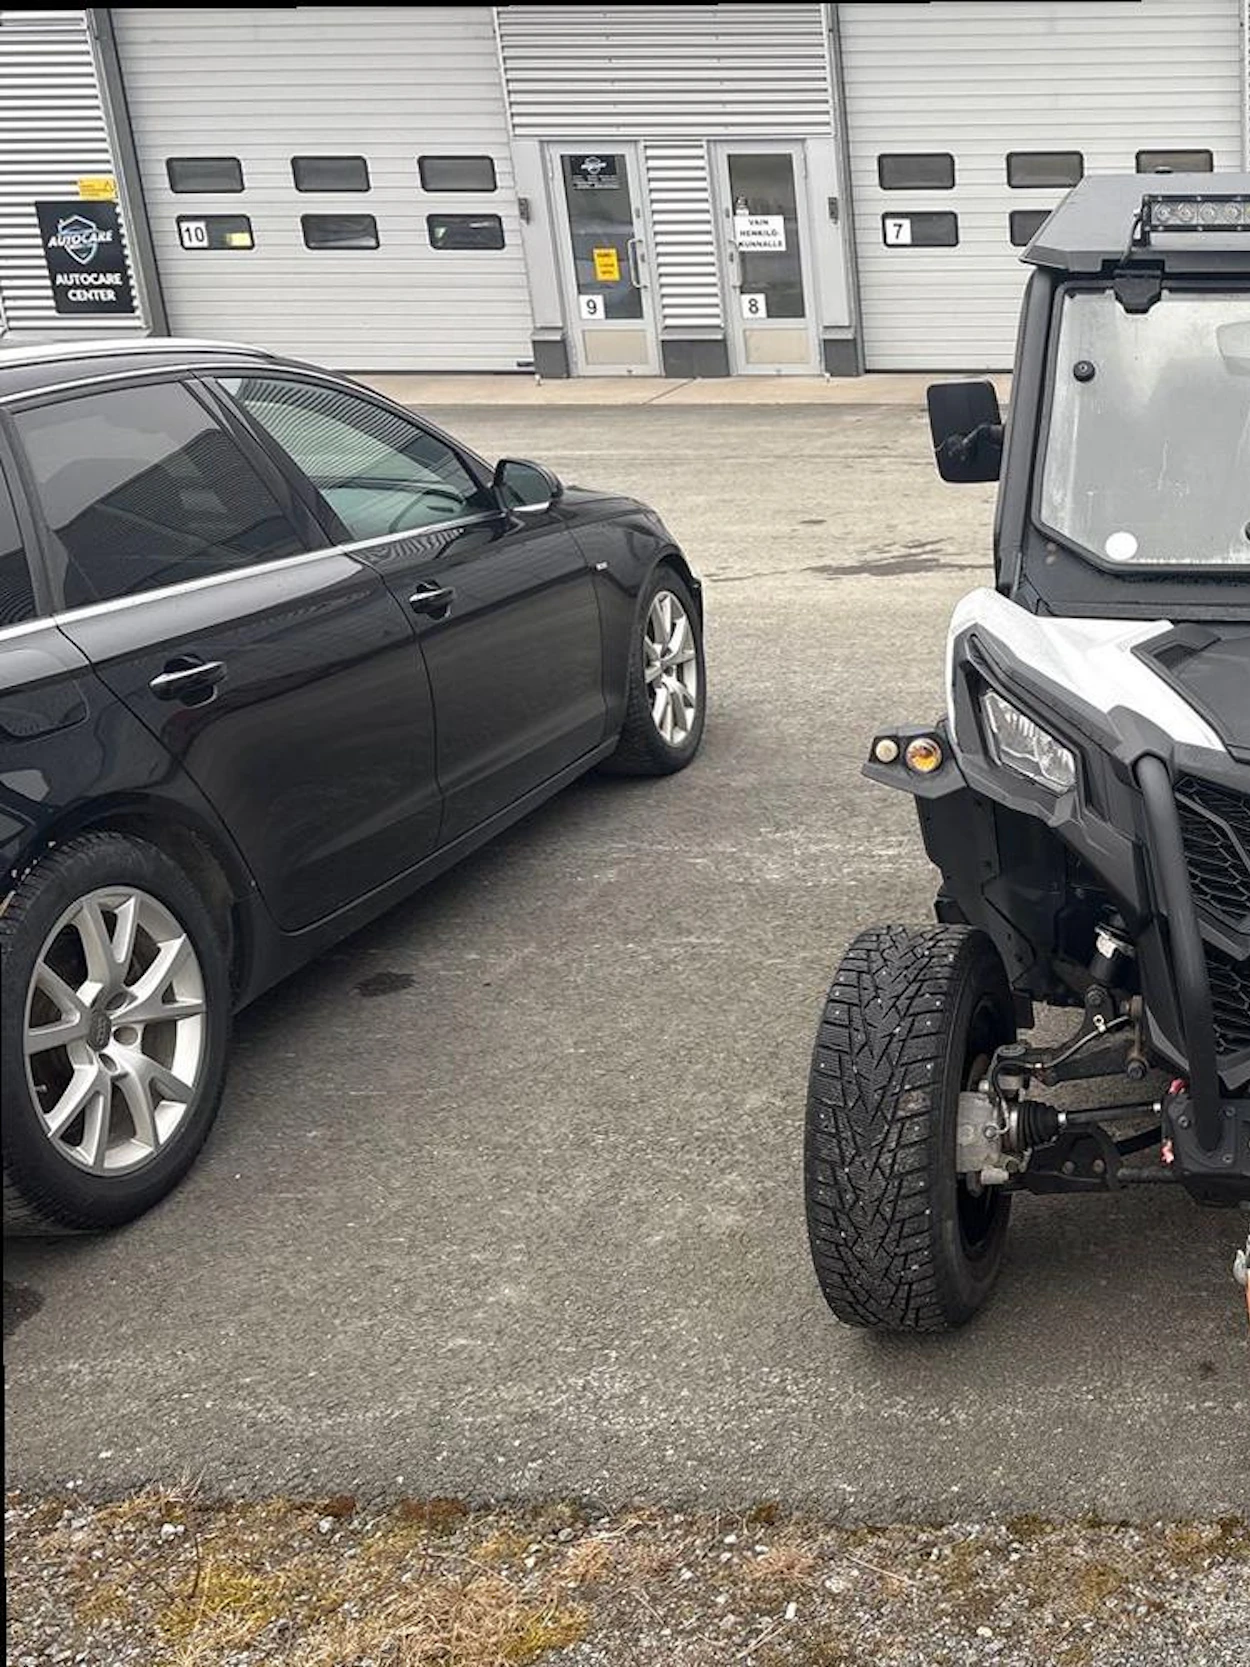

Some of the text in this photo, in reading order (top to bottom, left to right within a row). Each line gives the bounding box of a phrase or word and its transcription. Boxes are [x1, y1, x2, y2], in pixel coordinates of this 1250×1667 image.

[48, 229, 113, 248] AUTOCARE
[184, 226, 205, 243] 10
[893, 222, 904, 240] 7
[56, 273, 123, 286] AUTOCARE
[67, 289, 117, 302] CENTER
[586, 298, 598, 315] 9
[748, 298, 759, 314] 8
